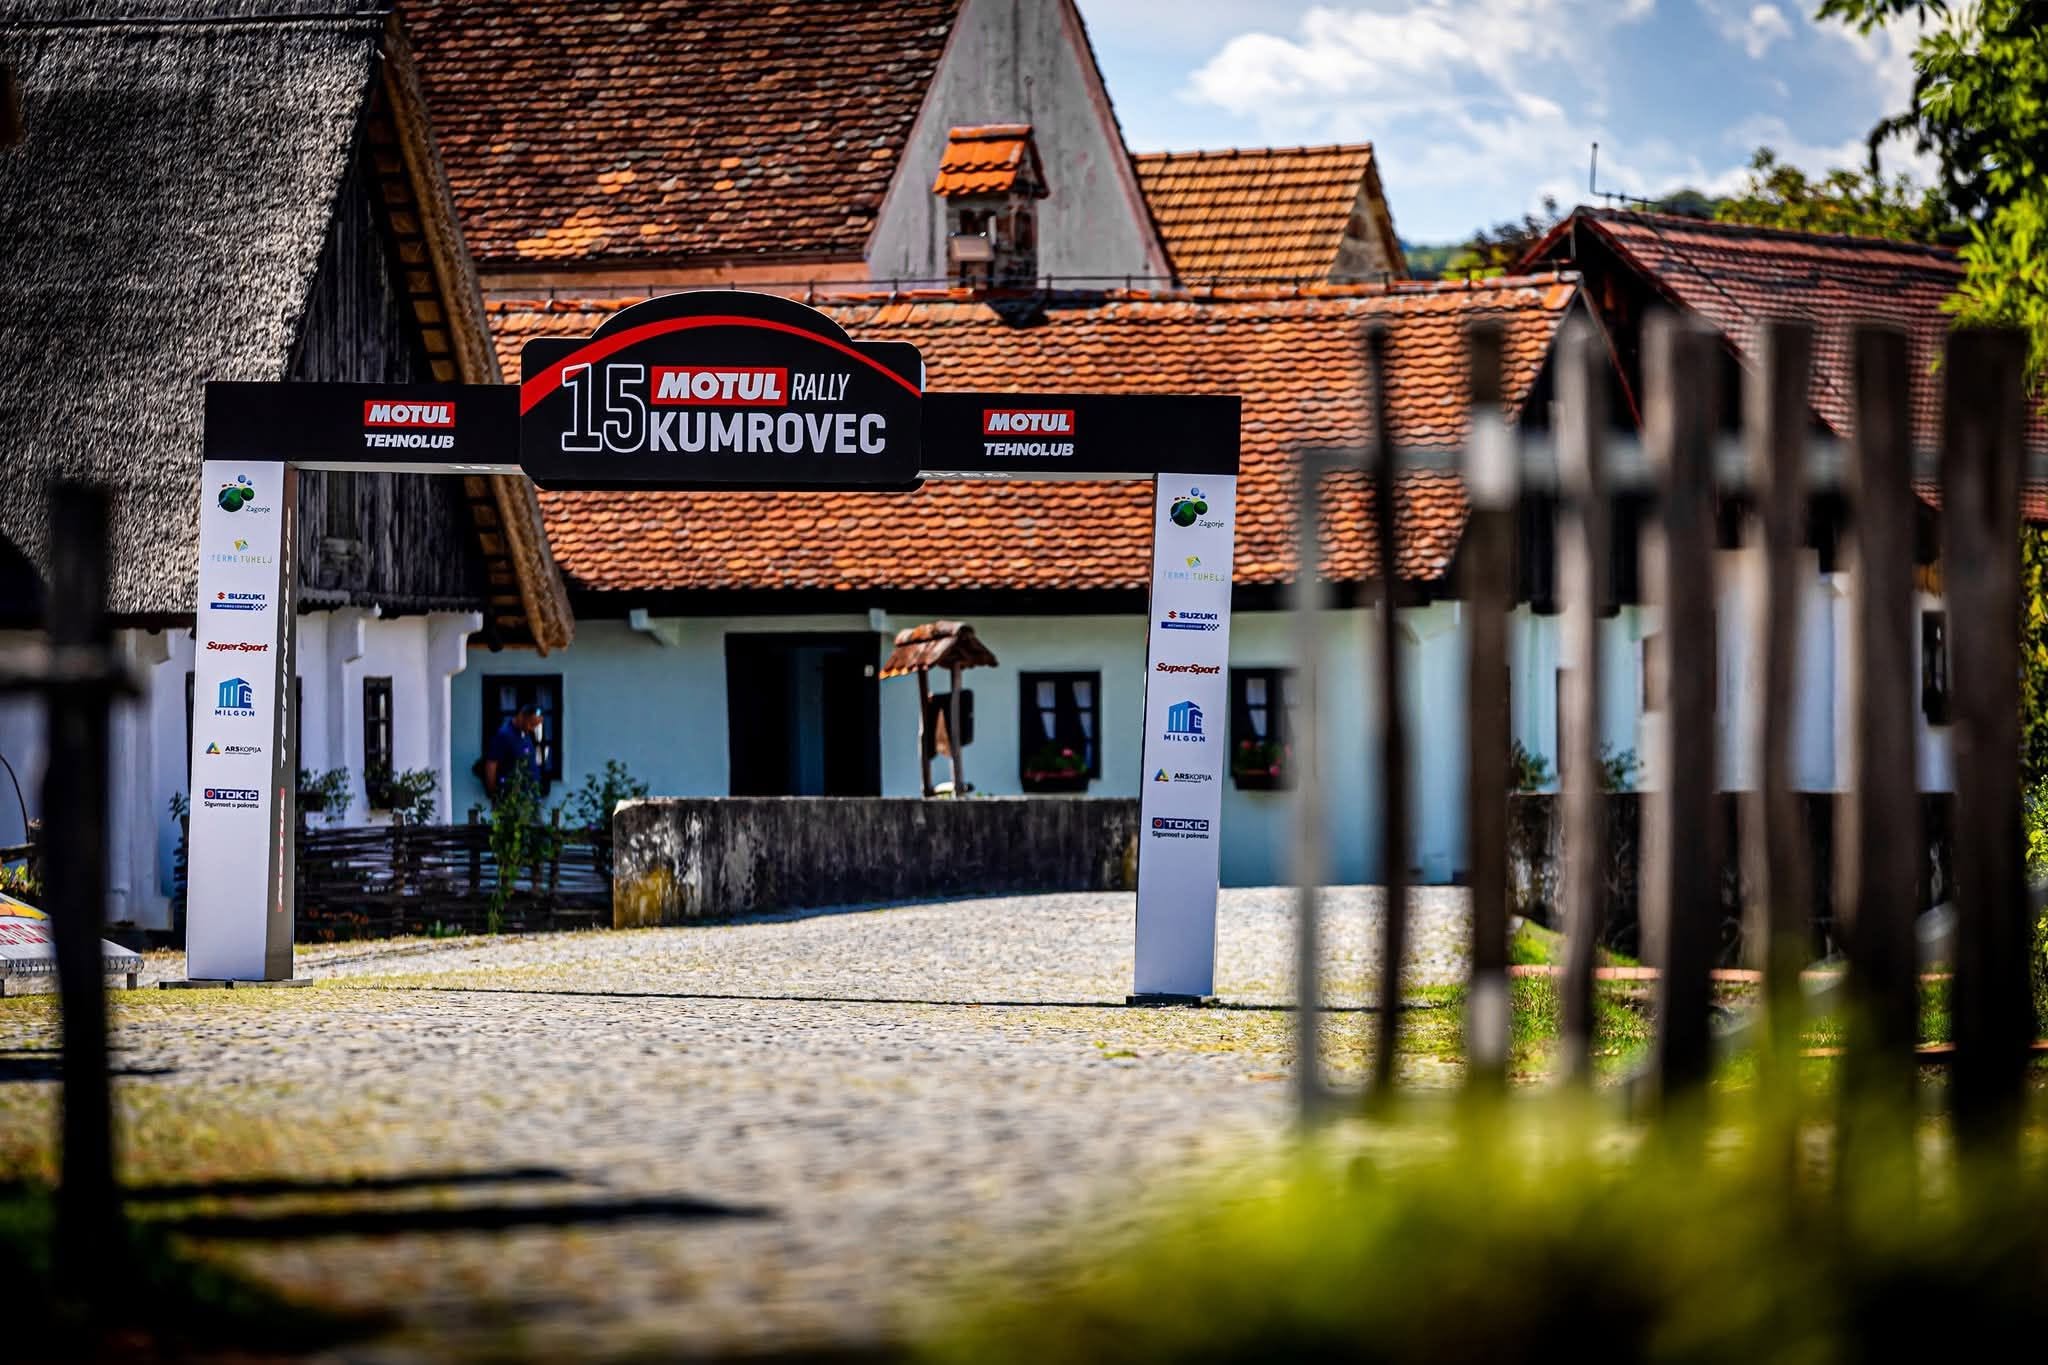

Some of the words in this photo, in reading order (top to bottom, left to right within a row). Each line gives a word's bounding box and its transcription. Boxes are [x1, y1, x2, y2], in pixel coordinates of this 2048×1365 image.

[657, 372, 782, 400] MOTUL
[791, 373, 850, 401] RALLY
[561, 363, 646, 453] 15
[368, 404, 451, 424] MOTUL
[988, 413, 1071, 432] MOTUL
[650, 411, 886, 454] KUMROVEC
[364, 434, 455, 448] TEHNOLUB
[984, 443, 1074, 456] TEHNOLUB
[246, 505, 271, 513] Zagorje
[1199, 519, 1225, 528] Zagorje
[228, 592, 265, 600] SUZUKI
[1179, 611, 1218, 620] SUZUKI
[206, 641, 268, 652] SuperSport
[1156, 662, 1220, 675] SuperSport
[215, 709, 255, 717] MILGON
[1164, 734, 1206, 742] MILGON
[225, 745, 261, 753] ARSKOPIJA
[1174, 772, 1212, 781] ARSKOPIJA
